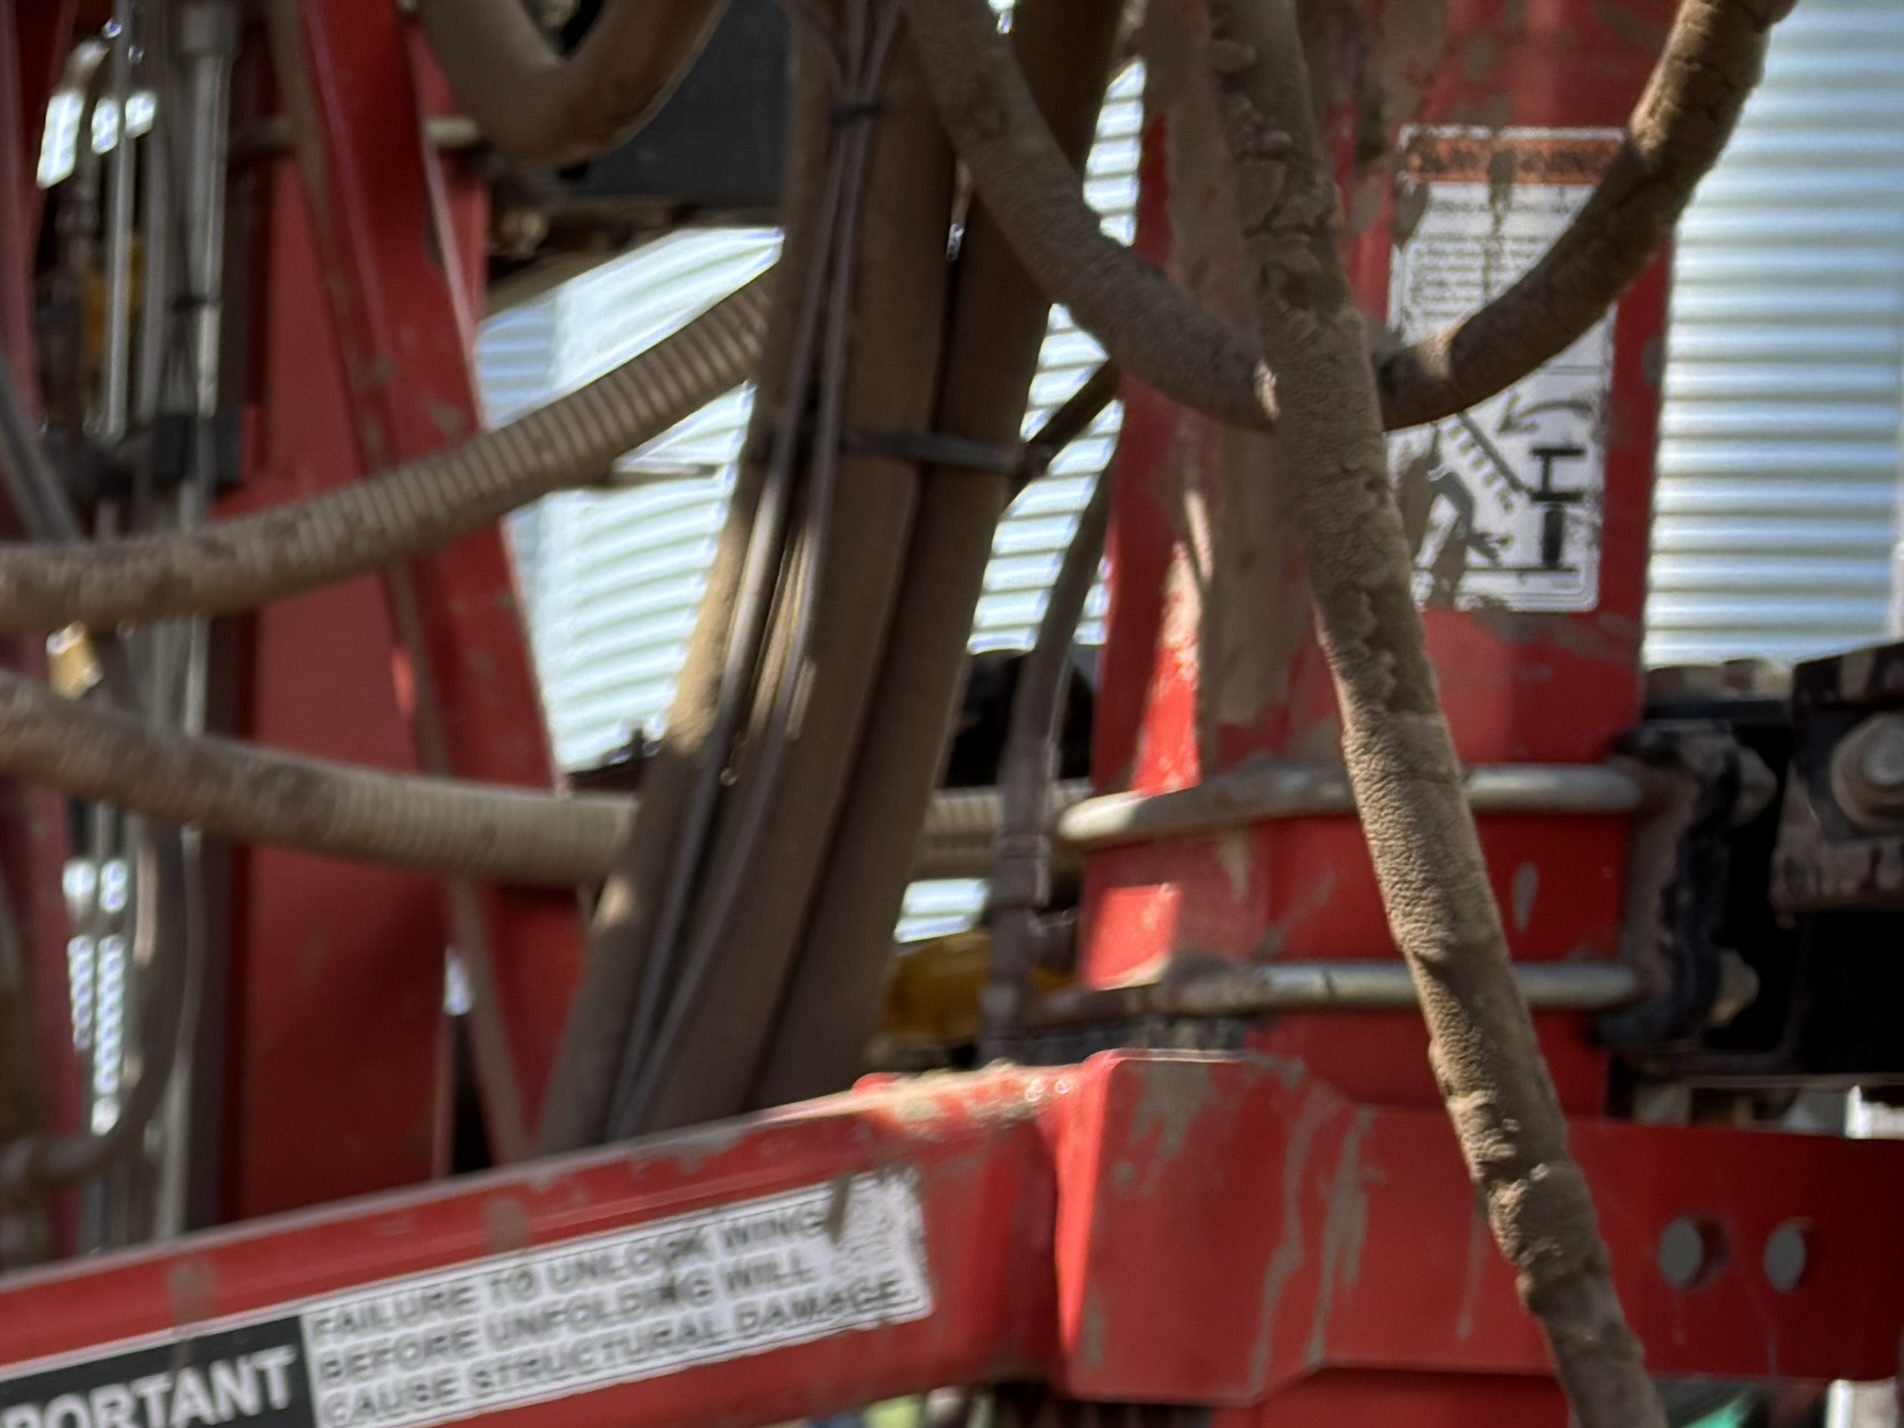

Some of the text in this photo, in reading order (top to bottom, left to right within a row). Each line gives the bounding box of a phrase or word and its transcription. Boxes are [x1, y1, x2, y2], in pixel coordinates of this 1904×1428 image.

[314, 1282, 477, 1338] FAILURE
[490, 1268, 535, 1302] TO
[547, 1228, 708, 1292] UNLOCK
[319, 1254, 817, 1386] BEFORE UNFOLDING WILL
[470, 1321, 717, 1395] STRUCTURAL
